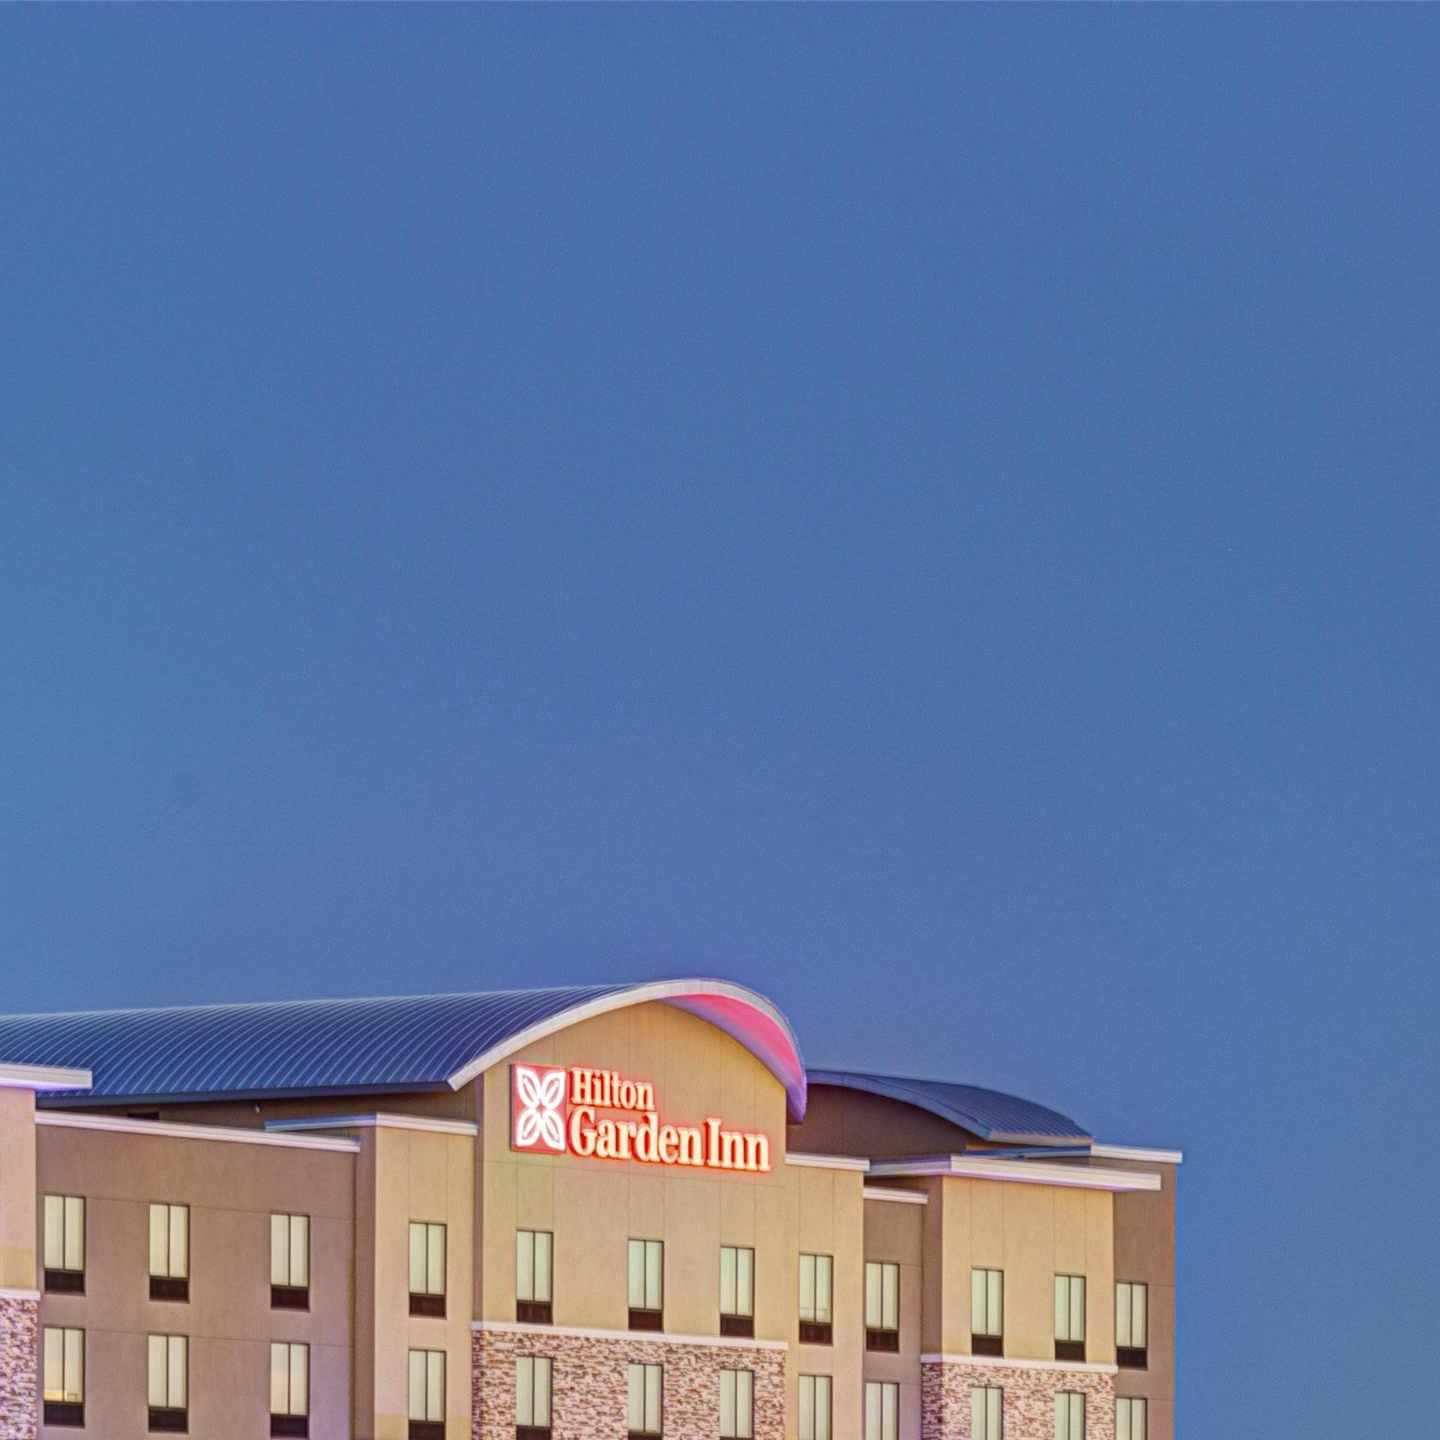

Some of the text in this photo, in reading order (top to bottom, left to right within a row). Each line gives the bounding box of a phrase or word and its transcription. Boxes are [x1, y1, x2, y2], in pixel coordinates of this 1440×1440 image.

[571, 1068, 655, 1111] Hilton
[570, 1106, 771, 1172] Garden Inn
